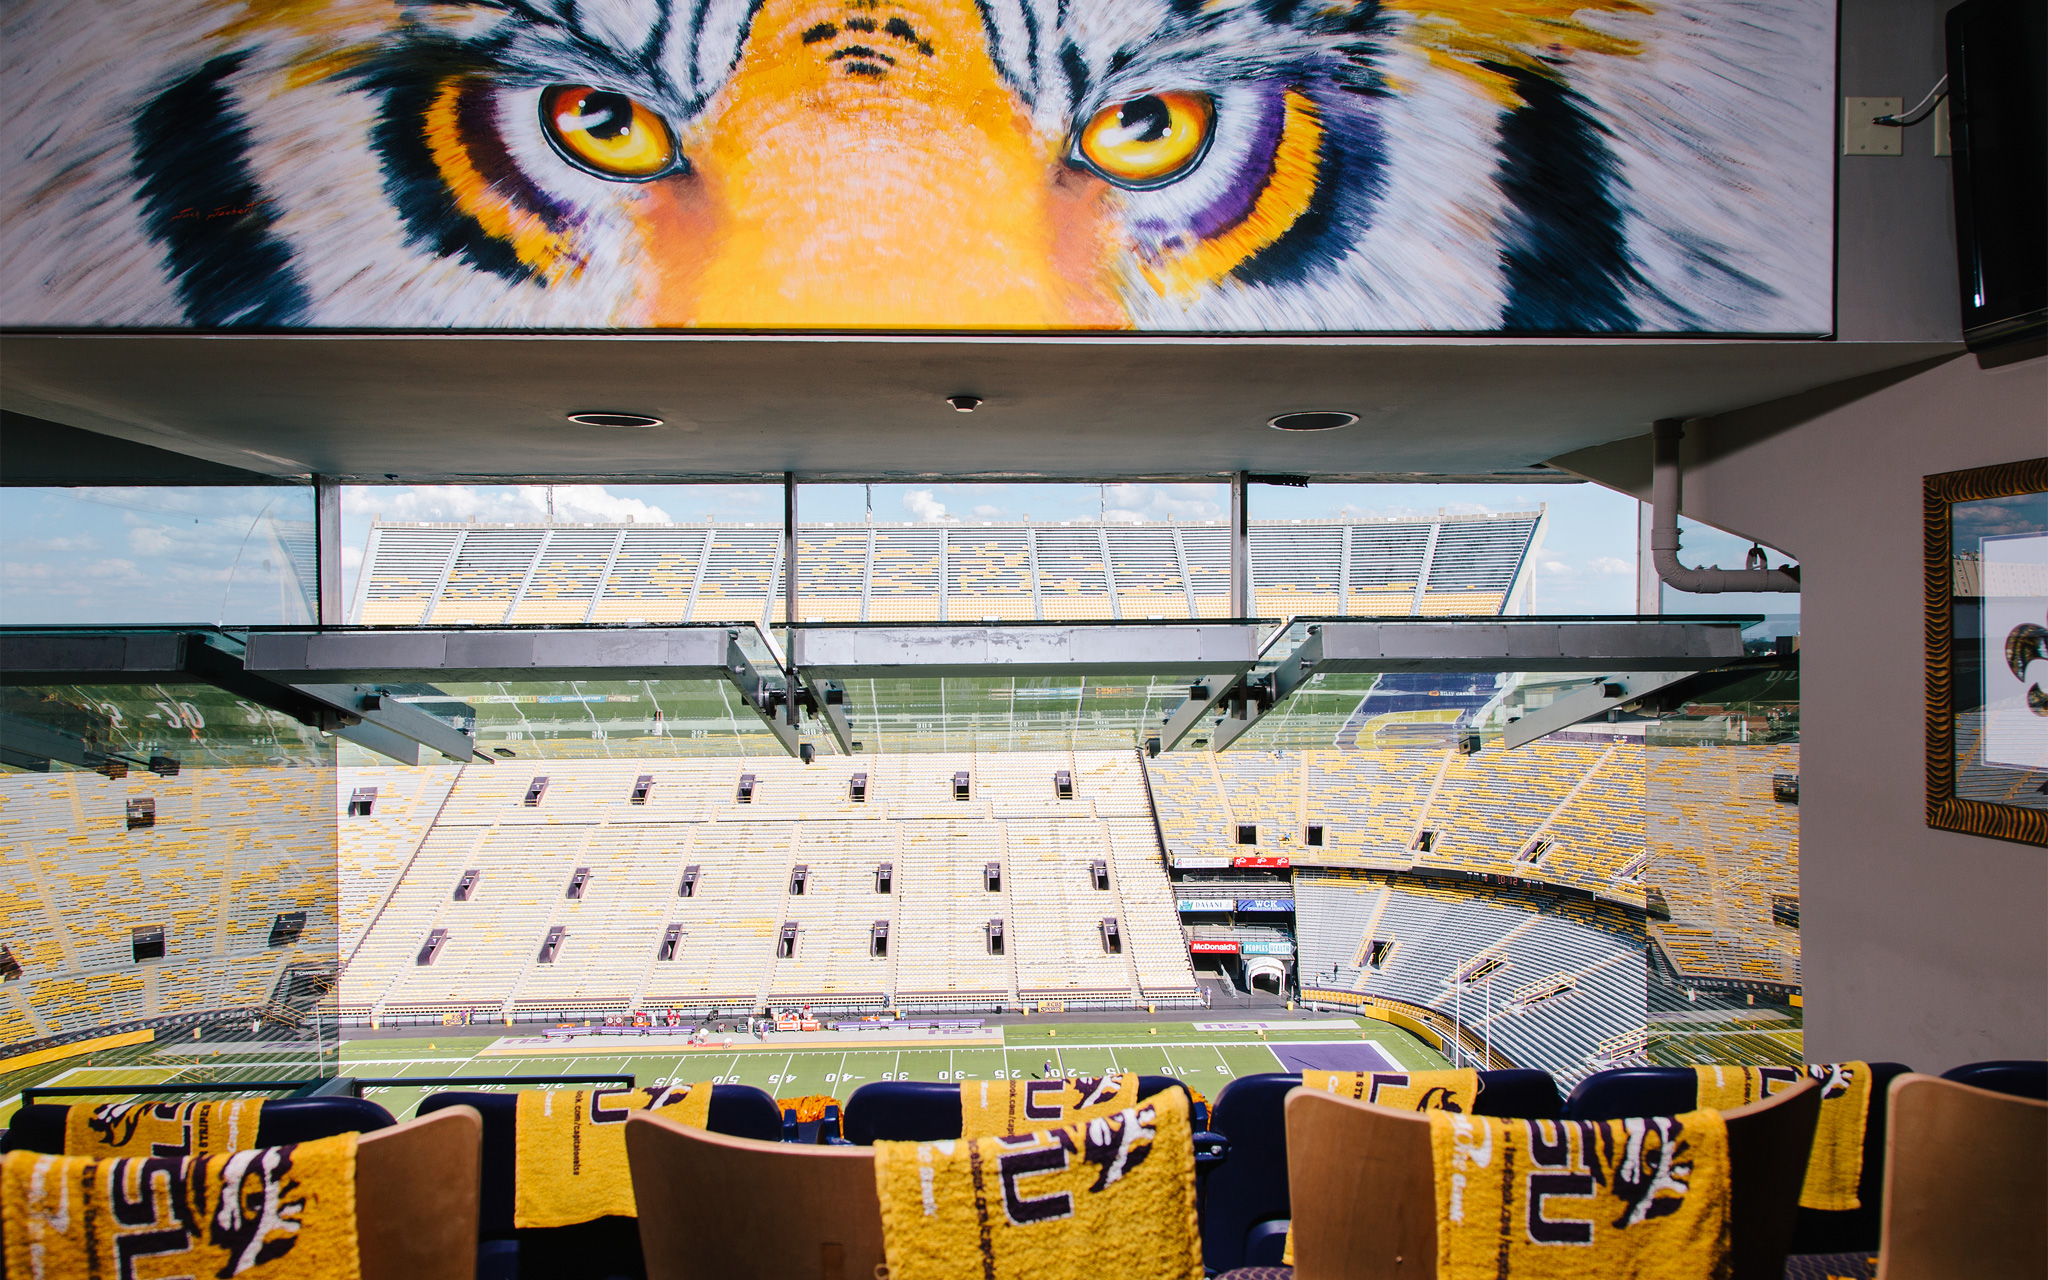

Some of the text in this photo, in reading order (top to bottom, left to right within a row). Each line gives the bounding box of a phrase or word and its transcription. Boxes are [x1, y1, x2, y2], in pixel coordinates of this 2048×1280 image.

[1192, 943, 1237, 951] McDonald's
[1245, 943, 1290, 952] PEOPLES HEALTH
